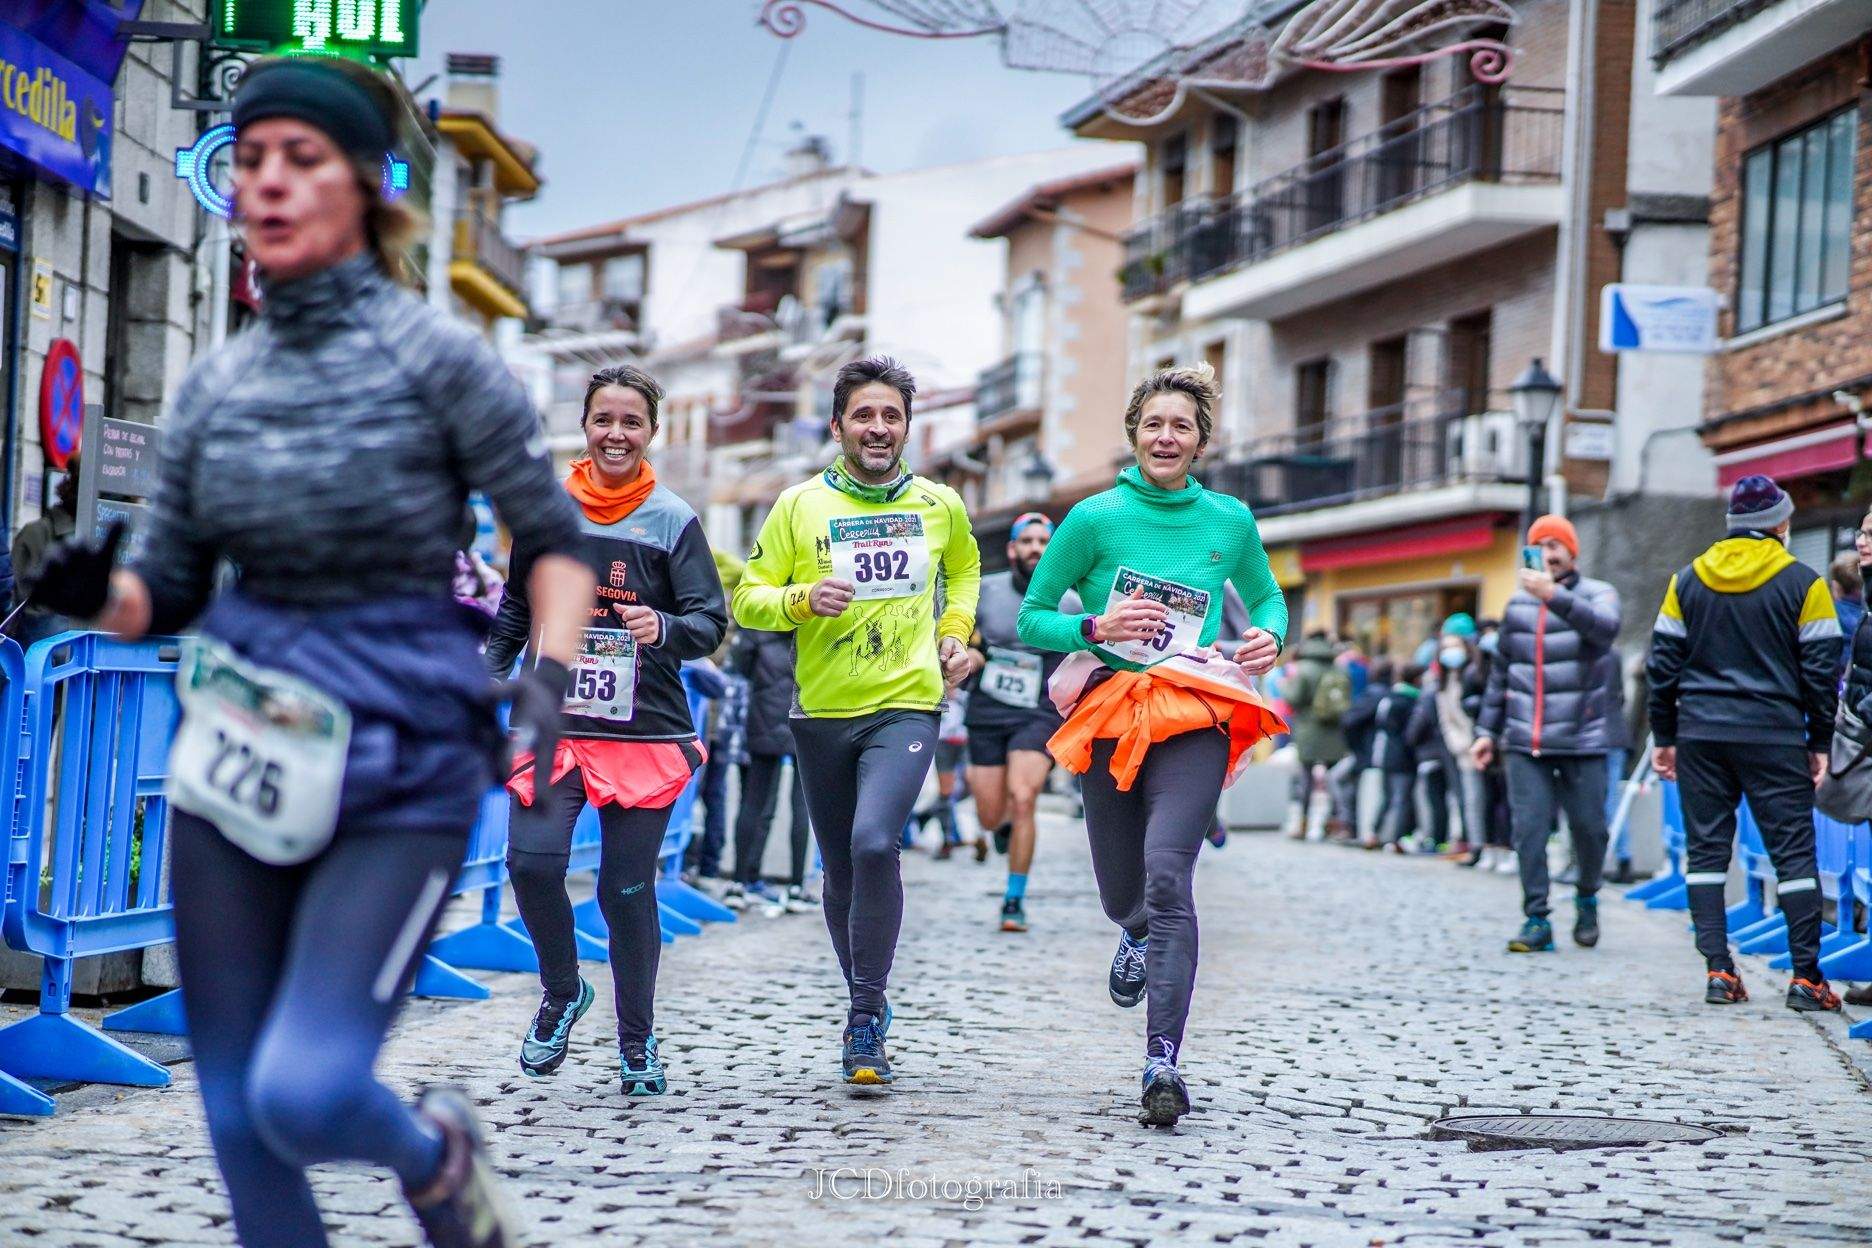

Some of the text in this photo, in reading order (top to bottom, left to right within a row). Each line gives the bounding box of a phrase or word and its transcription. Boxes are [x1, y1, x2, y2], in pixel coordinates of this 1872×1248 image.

[0, 59, 76, 142] cedilla
[833, 520, 864, 528] CARRERA
[873, 517, 903, 525] NAVIDAD
[854, 550, 910, 583] 392
[596, 586, 637, 601] SEGOVIA
[1122, 573, 1153, 587] CARRERA
[1162, 585, 1192, 598] NAVIDAD
[584, 633, 615, 641] NAVIDAD
[566, 668, 617, 701] 153
[207, 728, 284, 818] 226
